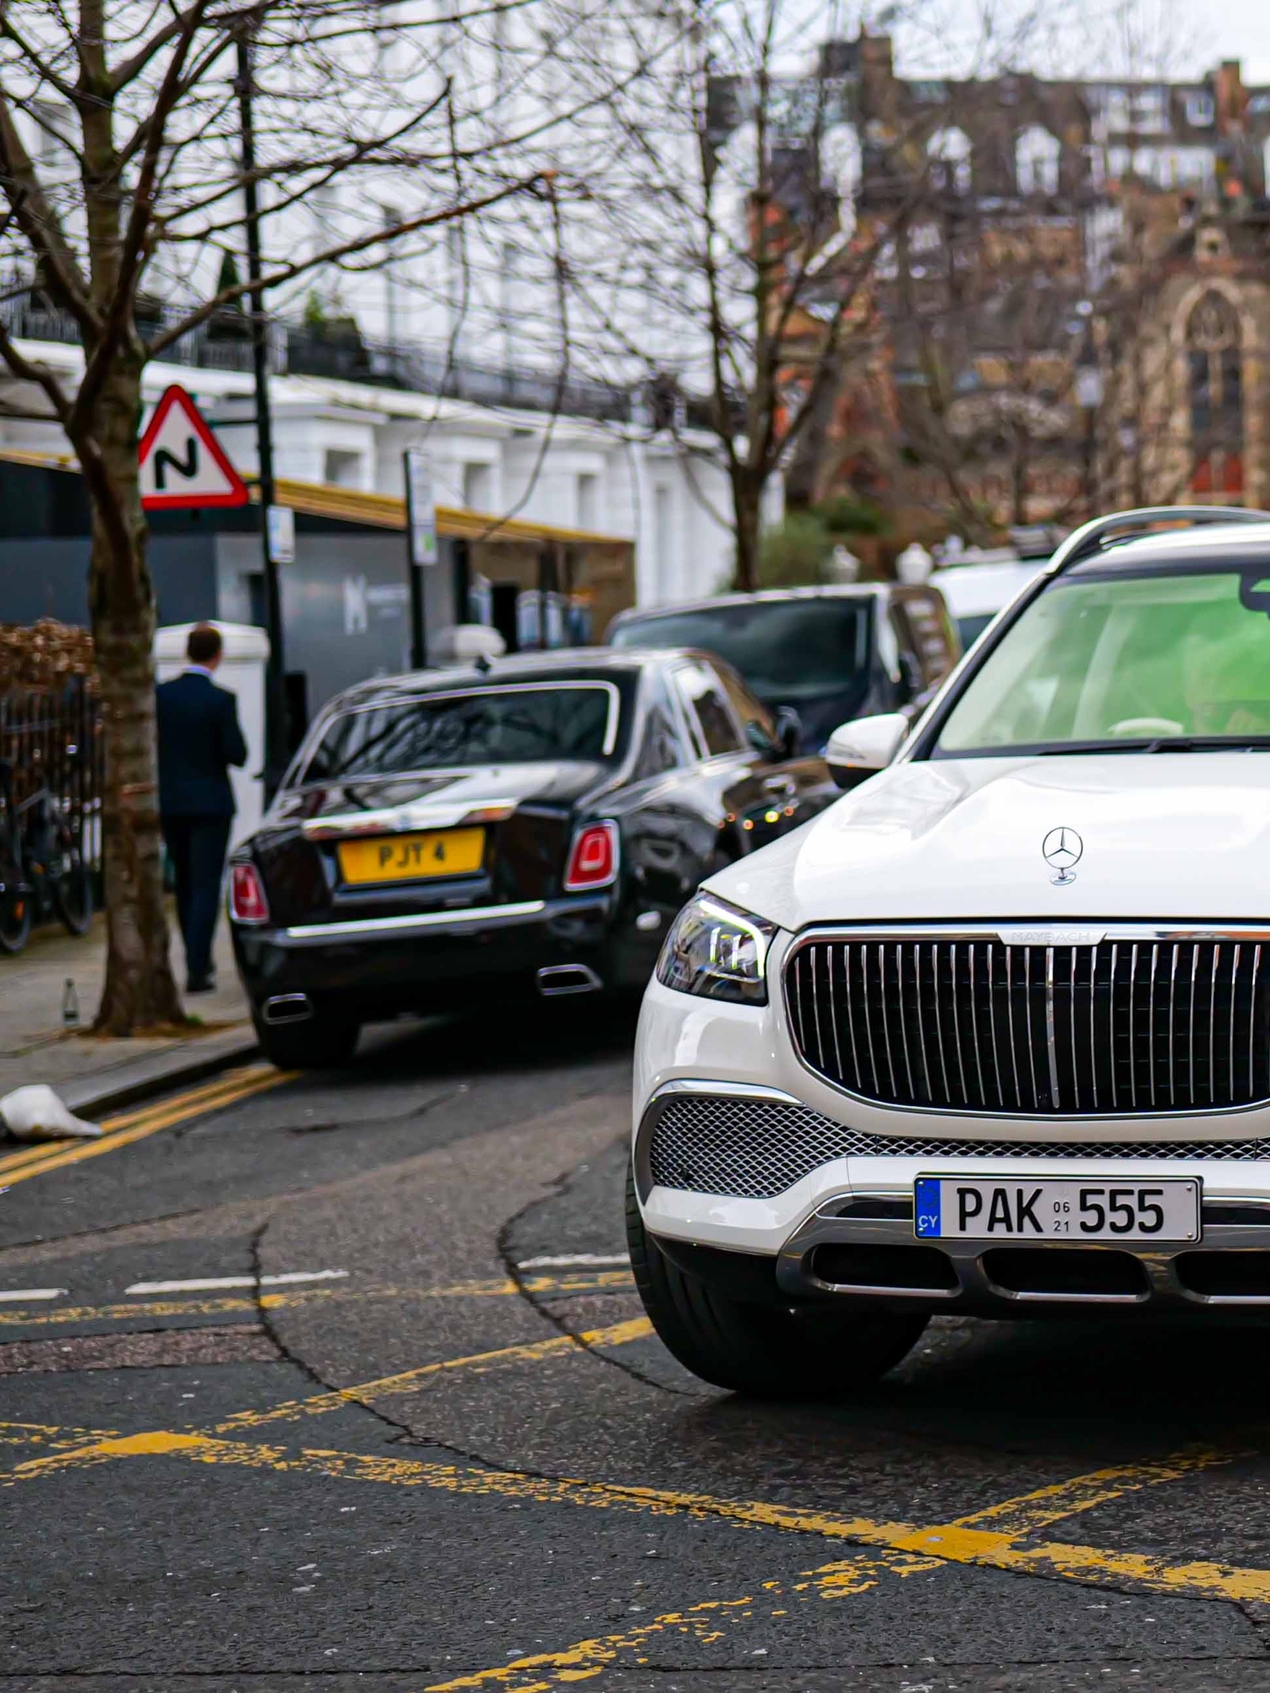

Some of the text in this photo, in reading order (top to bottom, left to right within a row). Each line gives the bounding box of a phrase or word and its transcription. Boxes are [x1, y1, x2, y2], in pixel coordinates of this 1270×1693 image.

[1010, 931, 1090, 943] MAYBACH
[956, 1187, 1165, 1234] PAK 555
[1053, 1201, 1070, 1213] 06
[918, 1215, 939, 1229] CY
[1053, 1220, 1070, 1232] 21
